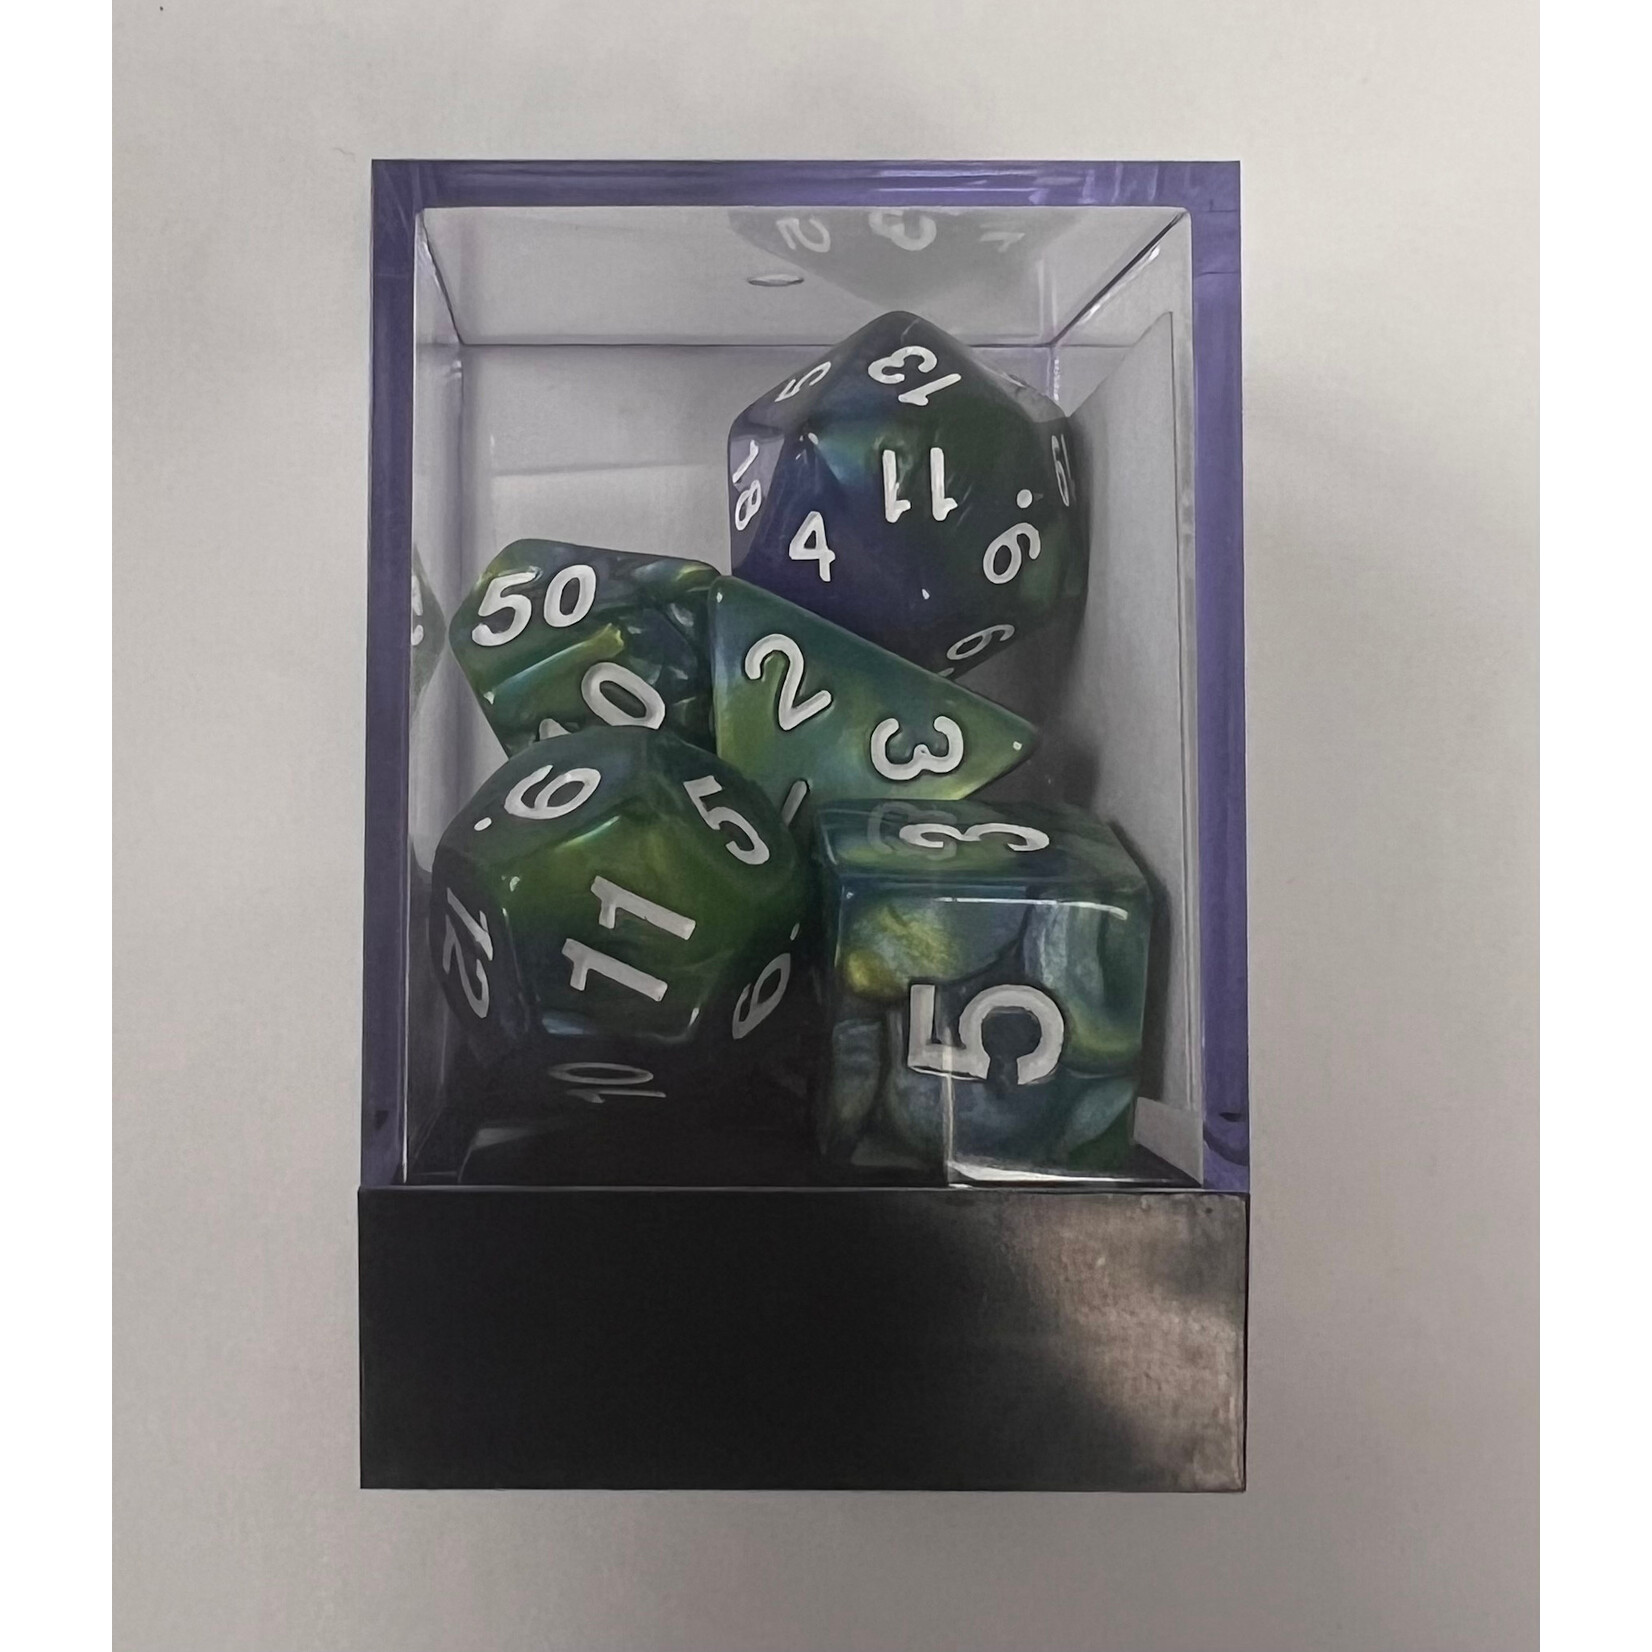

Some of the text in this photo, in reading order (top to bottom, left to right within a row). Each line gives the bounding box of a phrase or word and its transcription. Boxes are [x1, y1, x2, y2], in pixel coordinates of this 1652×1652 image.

[867, 345, 962, 406] 13
[732, 439, 762, 531] 18
[882, 446, 958, 523] 11
[788, 510, 836, 582] 4
[471, 564, 597, 647] 50
[744, 633, 832, 731] 2
[870, 715, 965, 781] 3
[682, 774, 770, 865] 5
[899, 822, 1050, 852] 3
[442, 887, 494, 1019] 12
[561, 875, 697, 1002] 11
[907, 983, 1065, 1086] 5
[547, 1061, 667, 1104] 10
